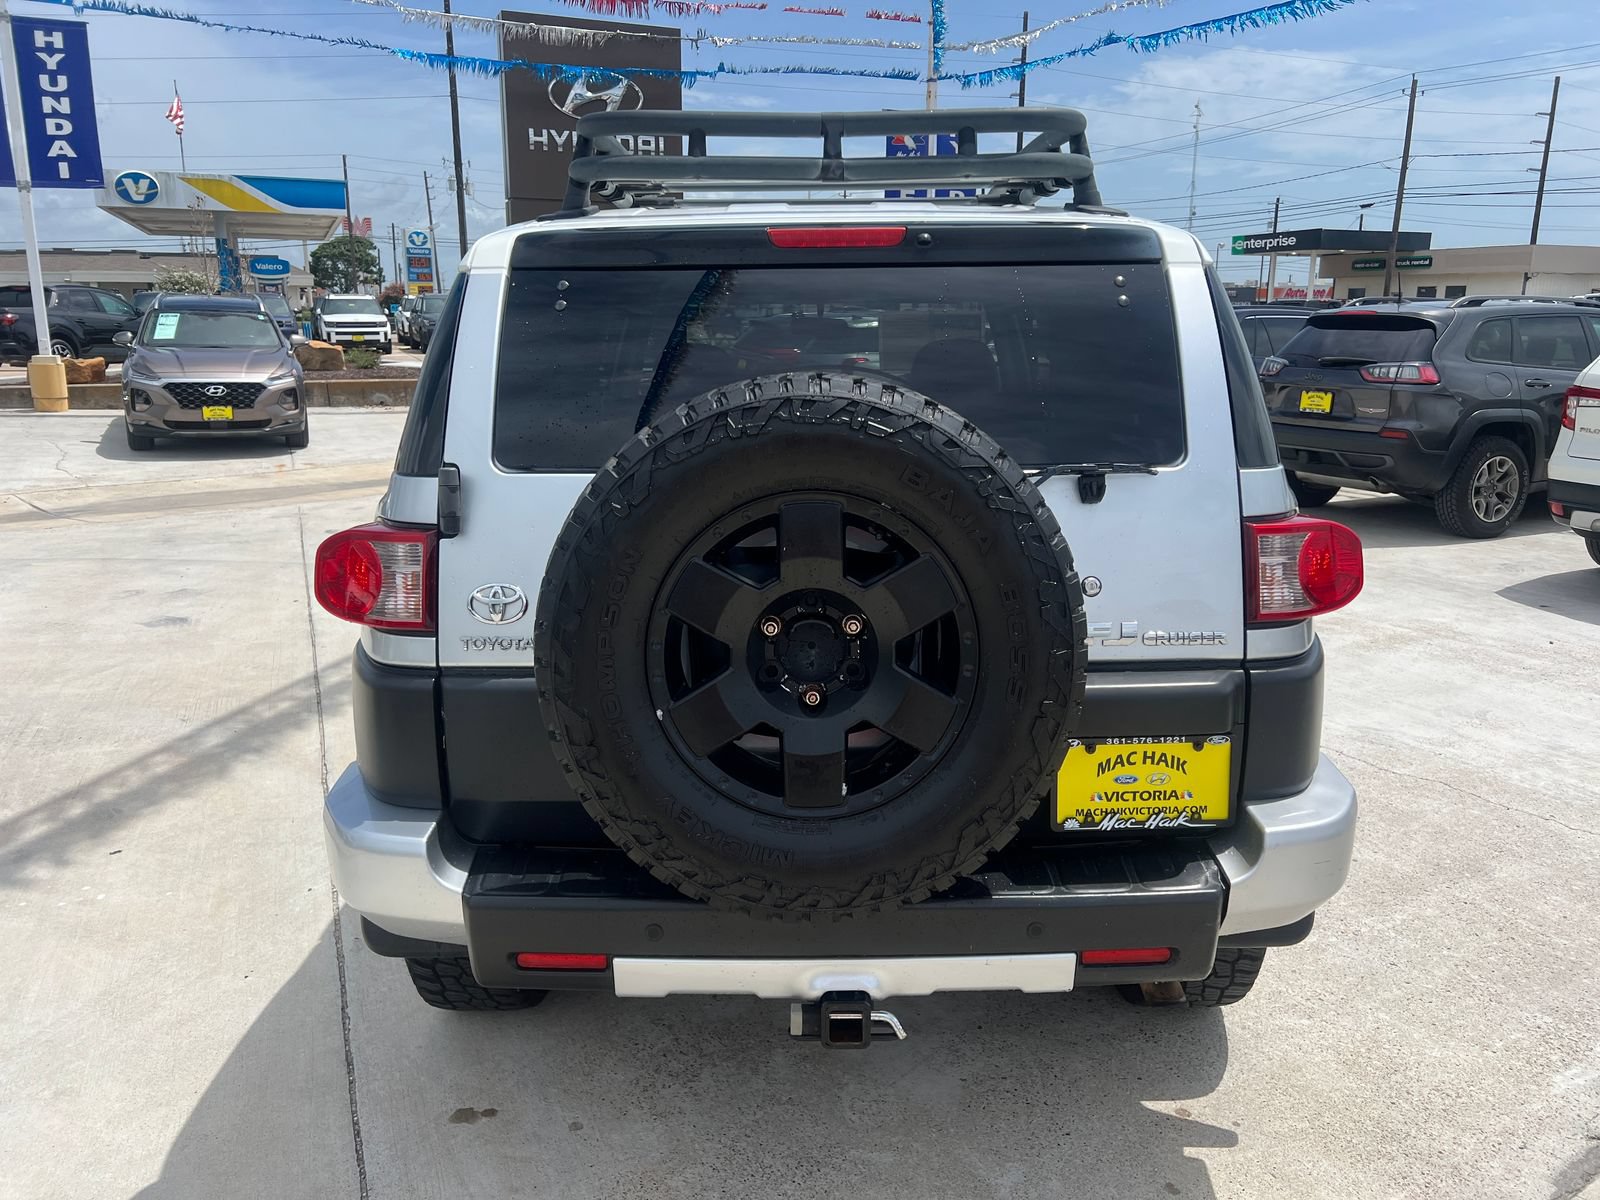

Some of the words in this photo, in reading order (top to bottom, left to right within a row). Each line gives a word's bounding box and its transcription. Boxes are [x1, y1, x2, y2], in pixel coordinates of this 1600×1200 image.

[34, 30, 77, 179] HYUNDAI
[528, 127, 664, 156] HYDAI
[1233, 235, 1297, 250] enterprise
[255, 262, 283, 270] Valero
[461, 636, 535, 651] TOYOTA
[1142, 630, 1229, 646] CRUISER
[1106, 736, 1186, 745] 361-576-1221
[1096, 751, 1138, 777] MAC
[1142, 750, 1188, 776] HAIK
[1116, 775, 1136, 784] Ford
[1103, 789, 1180, 802] VICTORIA
[1075, 805, 1208, 817] MACHAIKVICTORIA.COM
[1098, 813, 1143, 831] Mac
[1144, 811, 1193, 830] Haik
